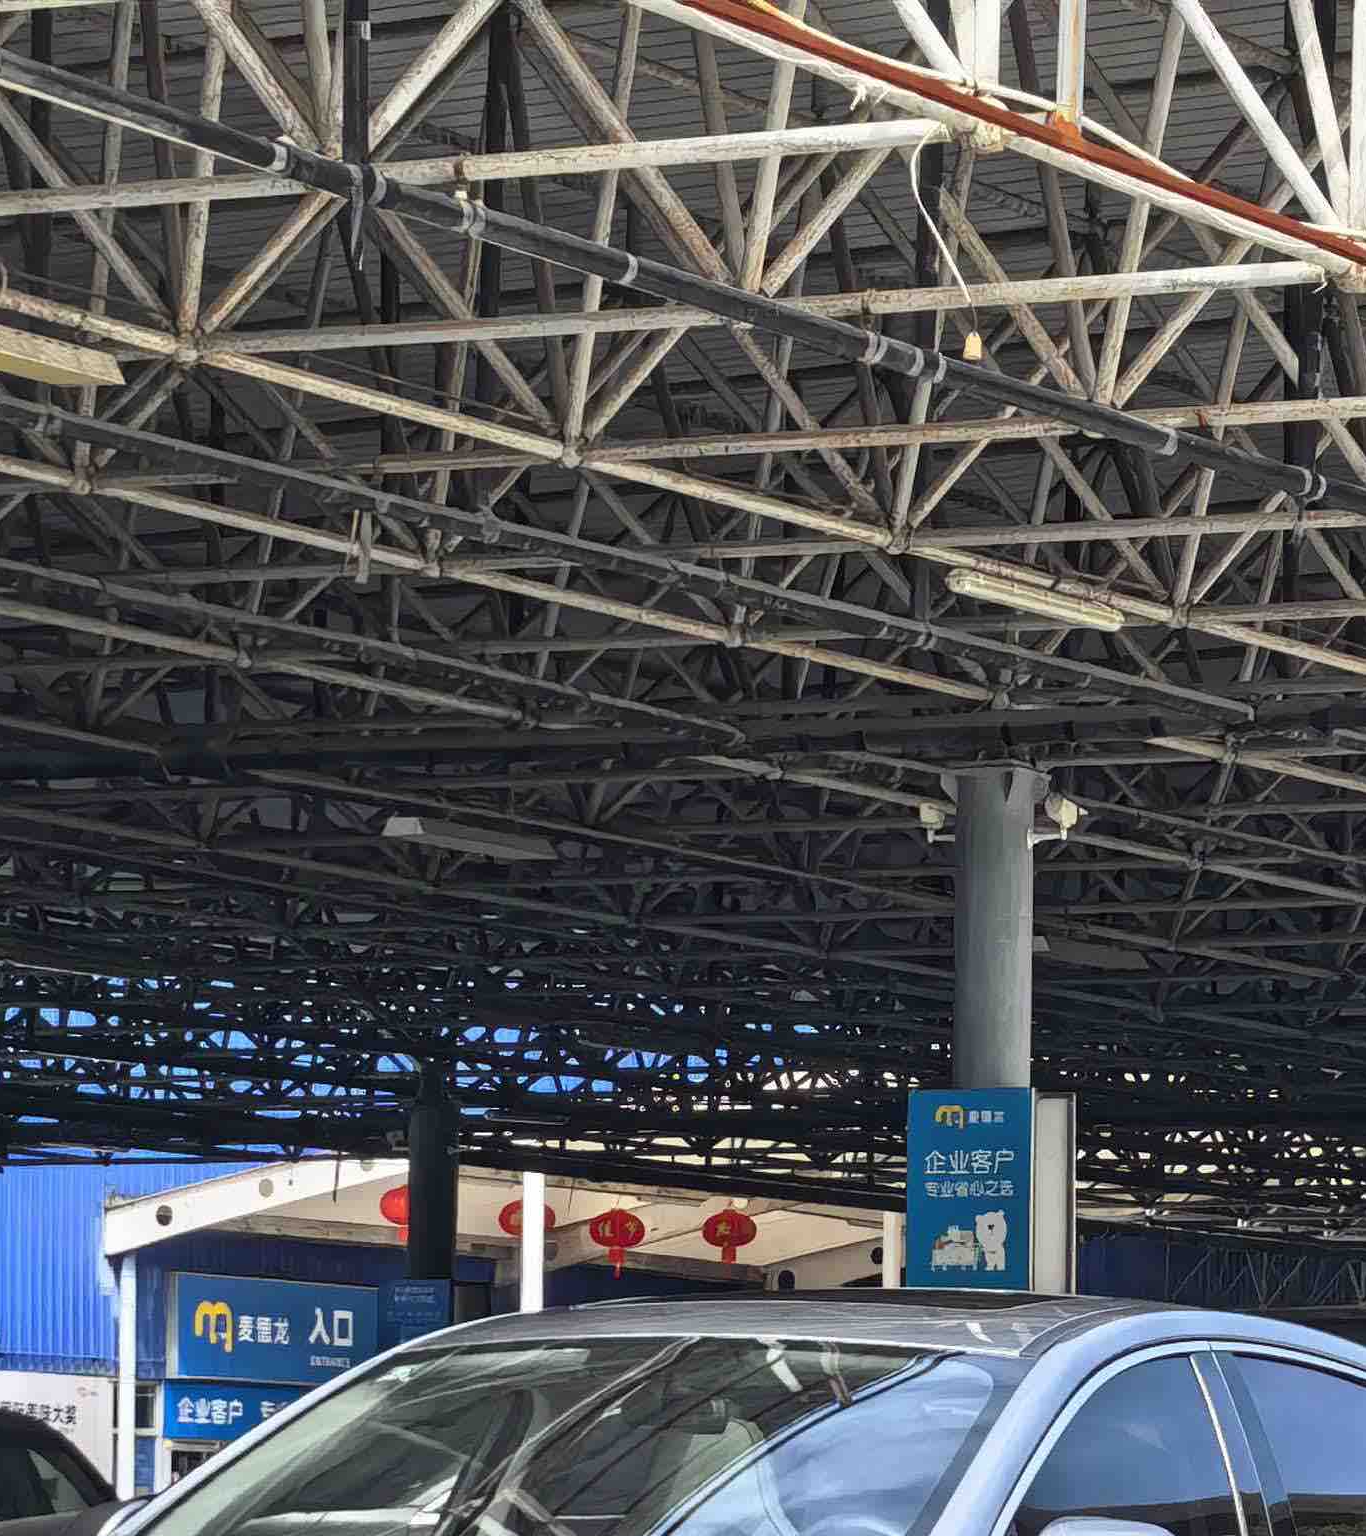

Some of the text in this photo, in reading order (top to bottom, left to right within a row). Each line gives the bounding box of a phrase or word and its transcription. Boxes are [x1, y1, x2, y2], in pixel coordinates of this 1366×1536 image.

[924, 1151, 1014, 1175] 企业客户
[309, 1307, 354, 1347] 入口
[177, 1397, 243, 1425] 企业客户
